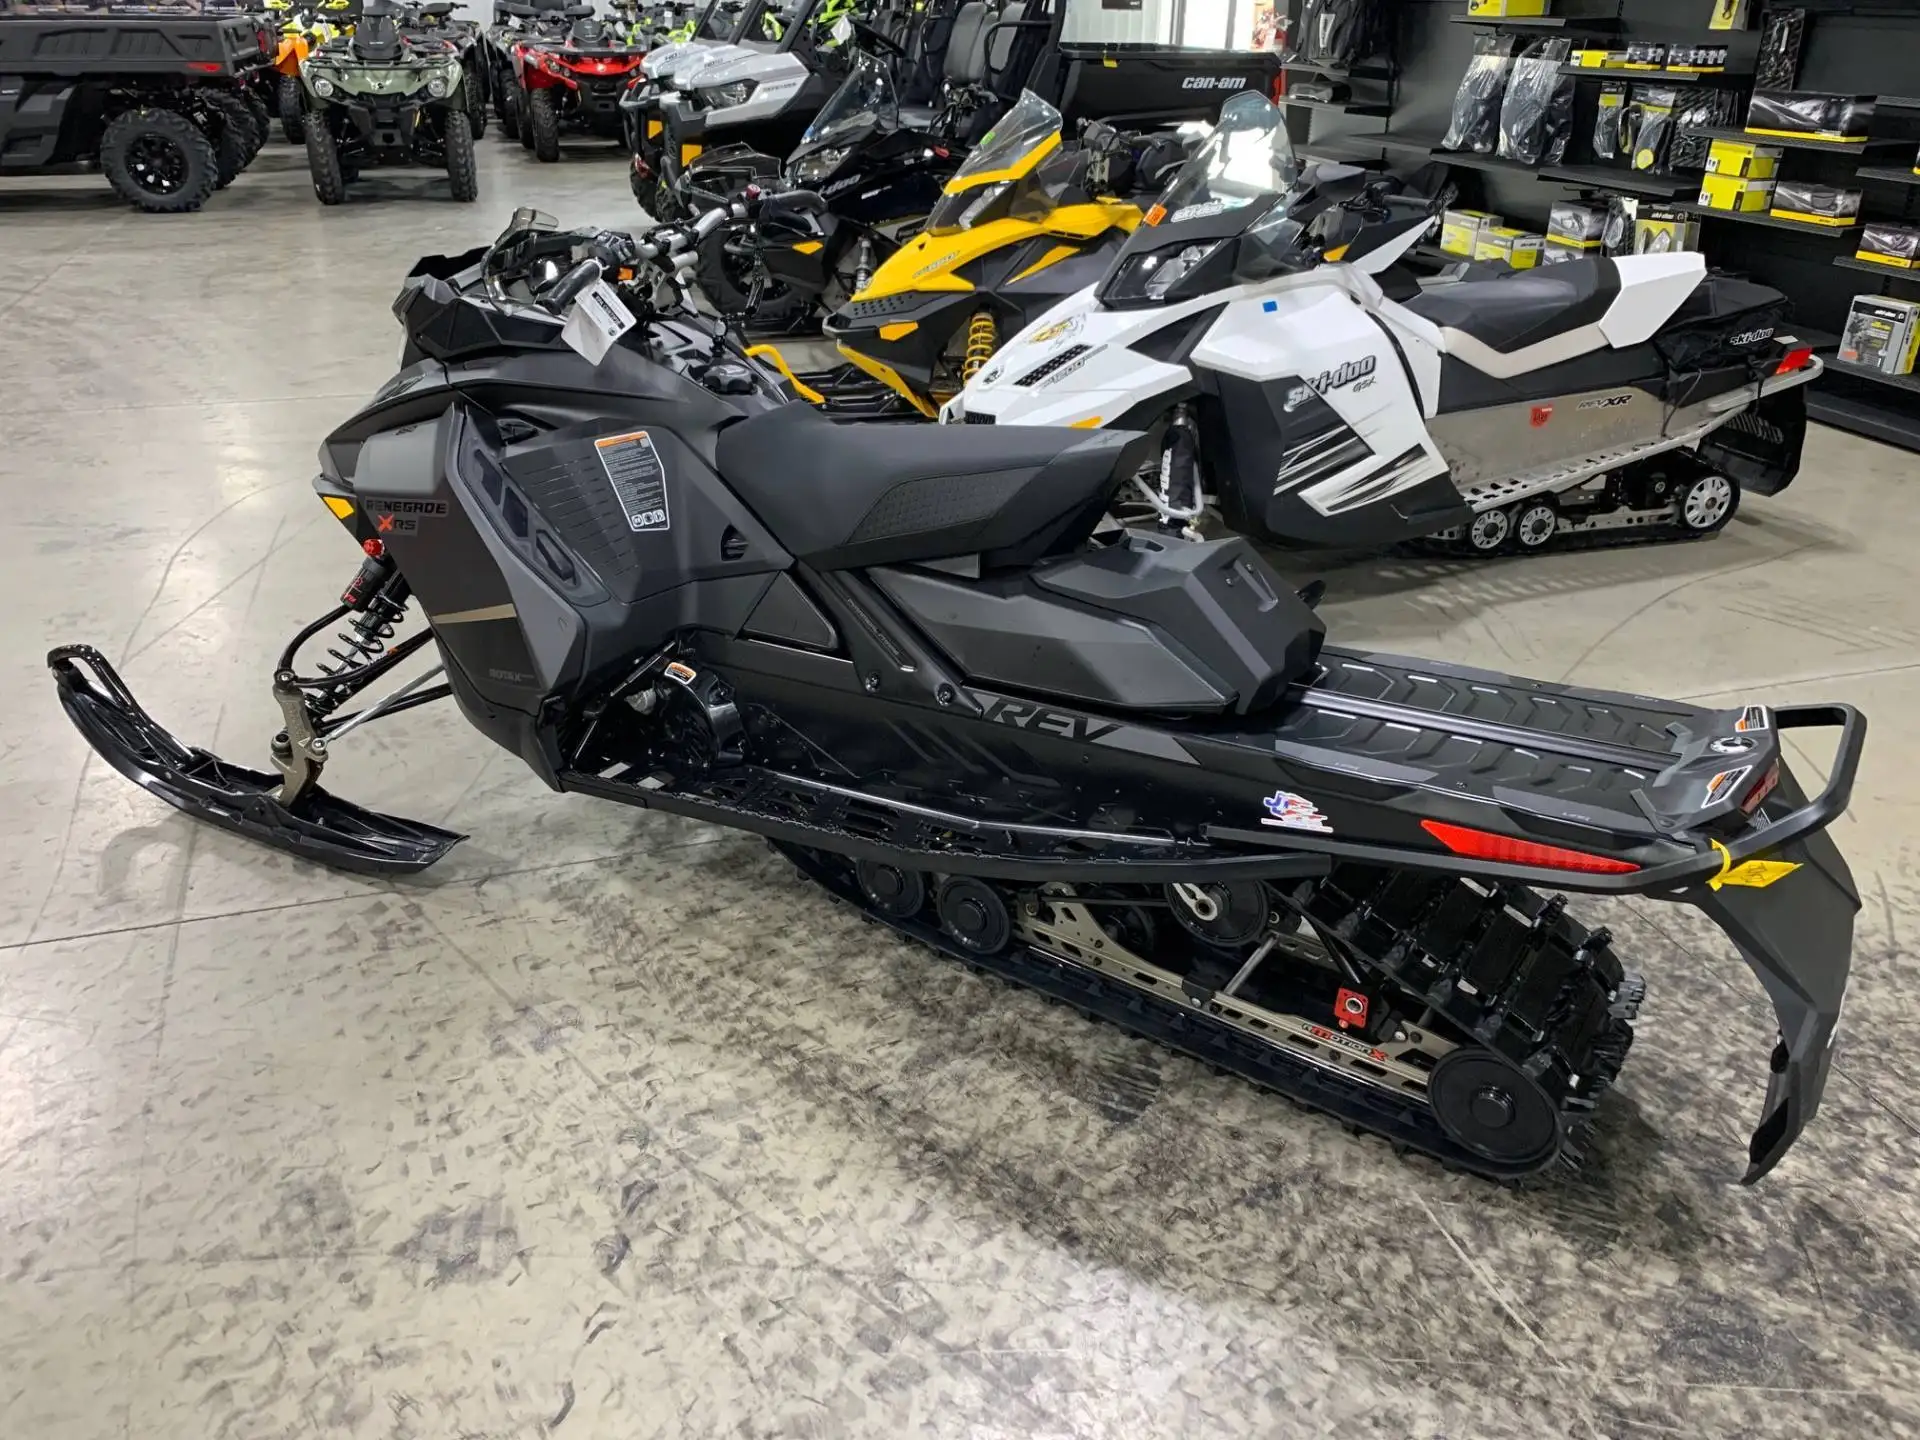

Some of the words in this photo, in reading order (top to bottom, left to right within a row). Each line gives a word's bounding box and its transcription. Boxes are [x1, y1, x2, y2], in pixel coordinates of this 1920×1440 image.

[1182, 76, 1247, 89] can-am
[1283, 355, 1377, 413] ski-doo
[365, 499, 448, 515] RENEGADE
[985, 699, 1124, 743] REV
